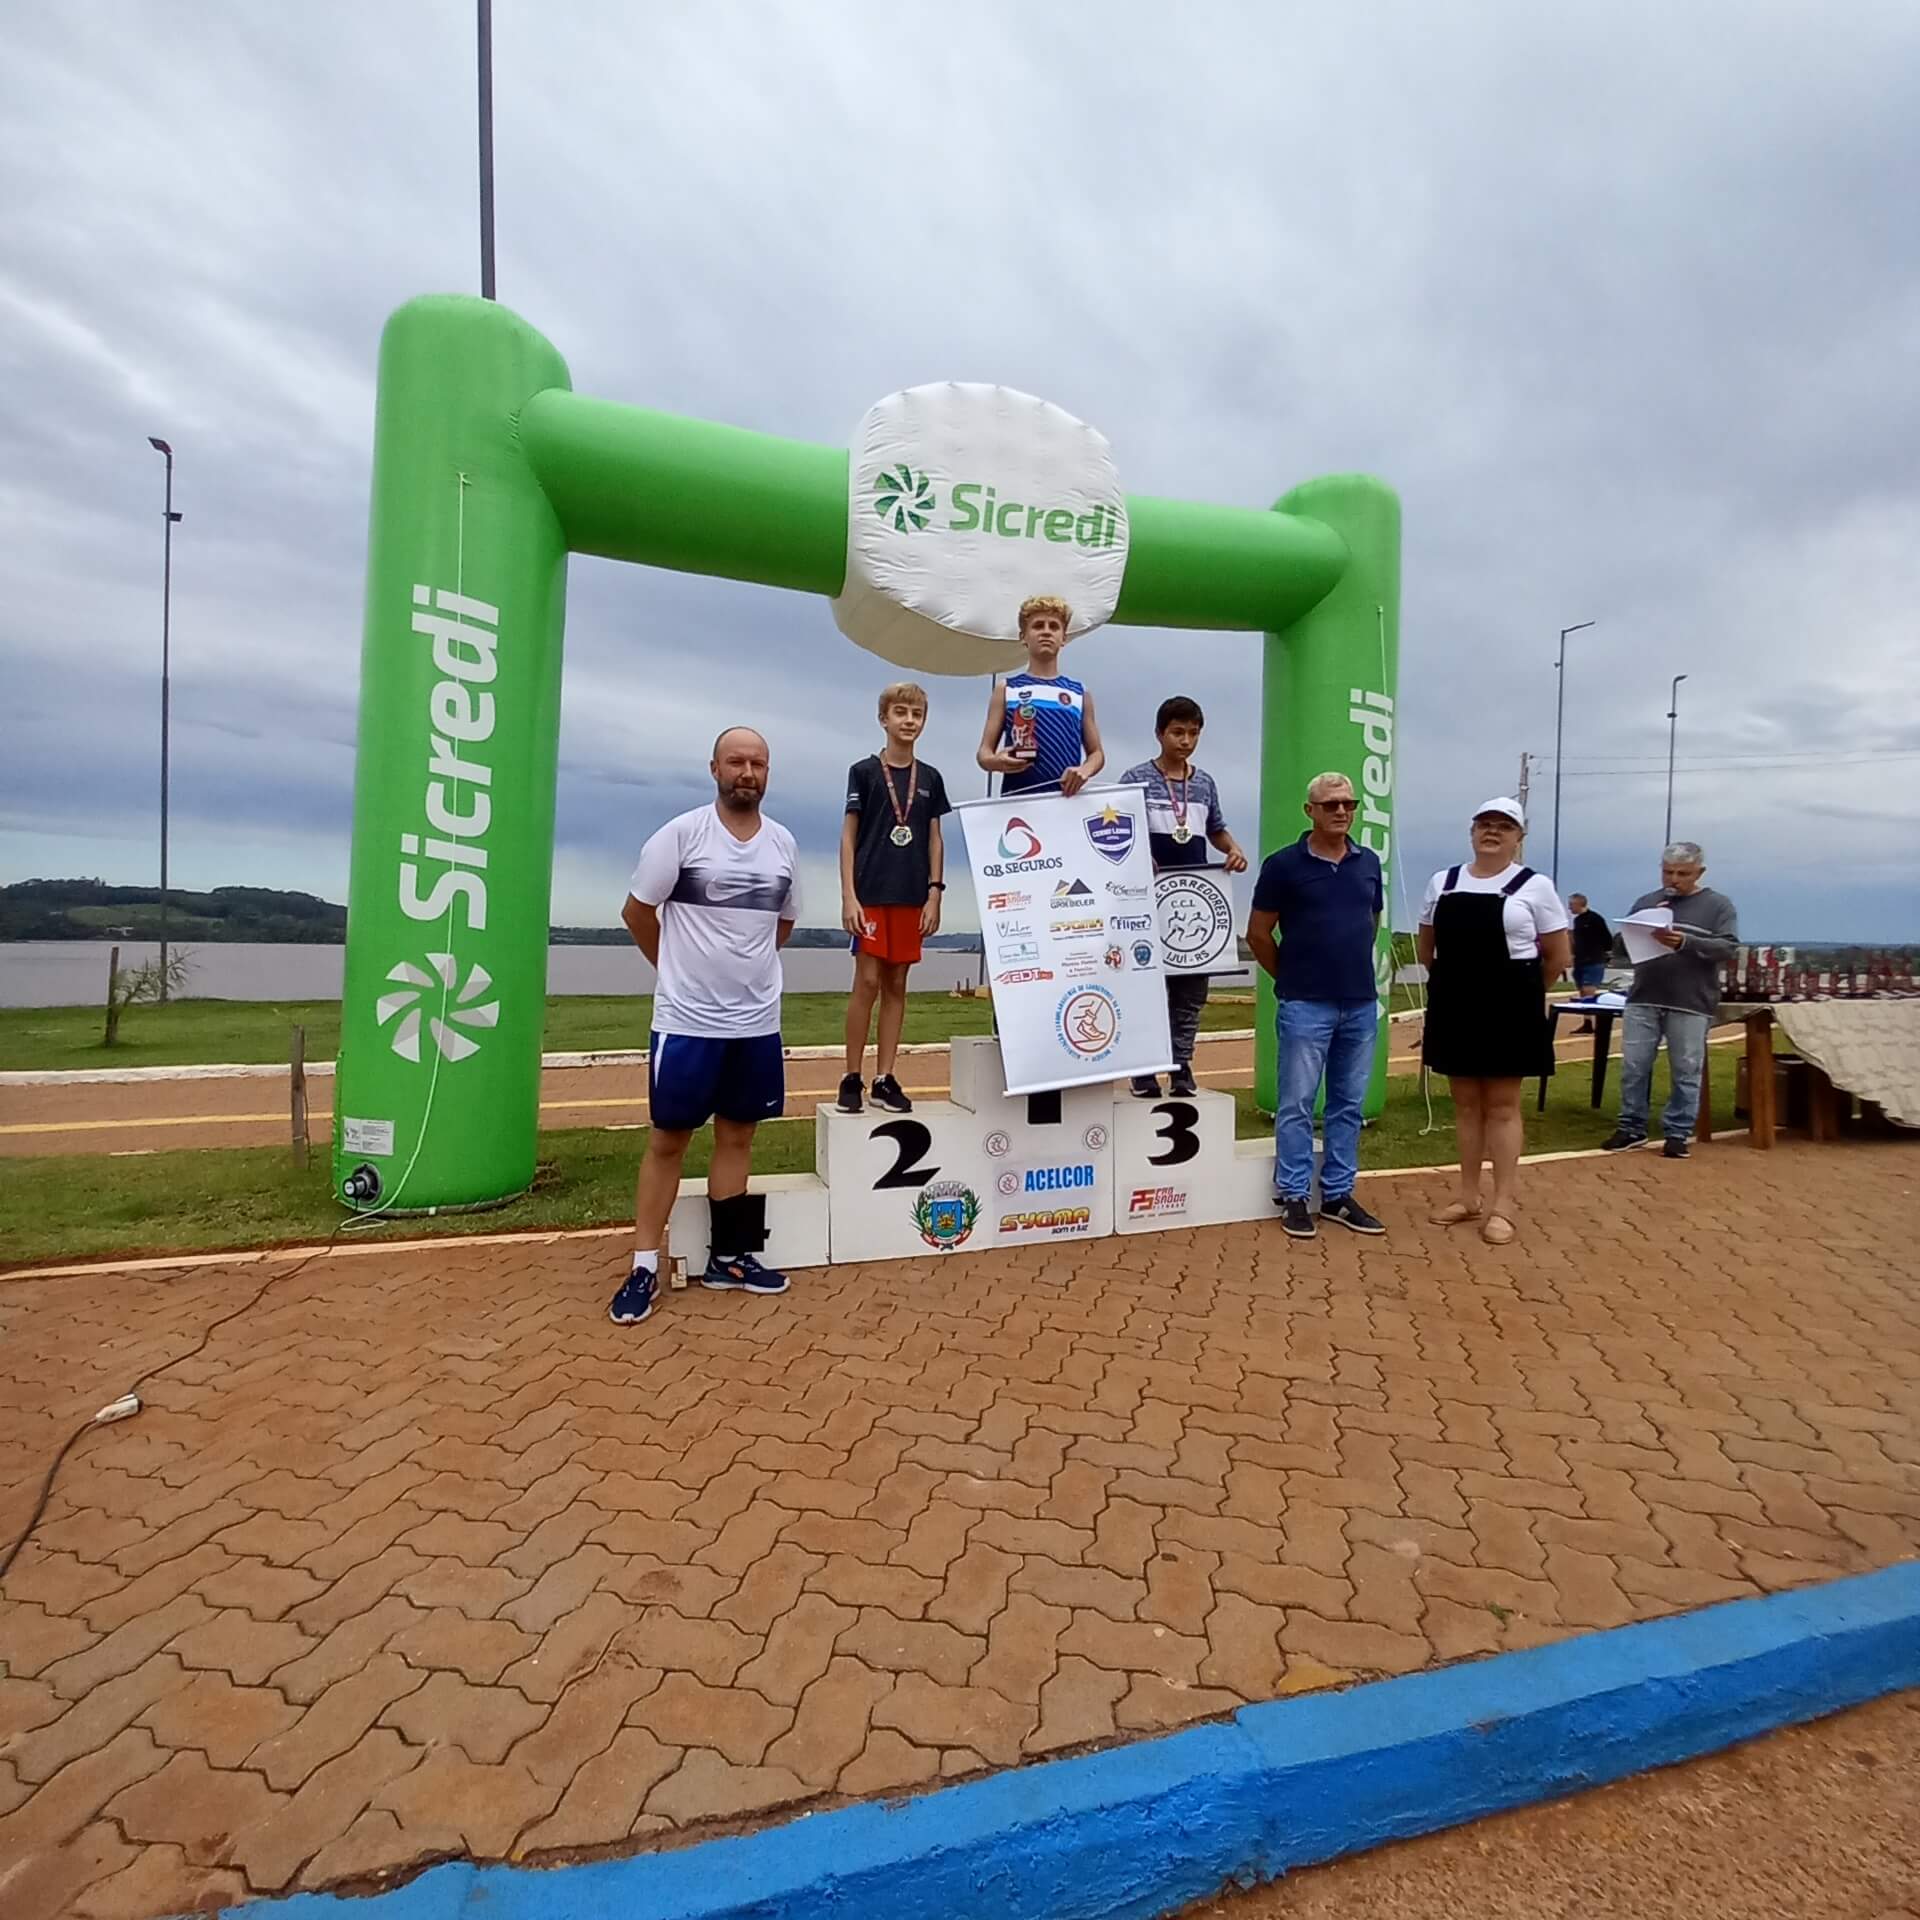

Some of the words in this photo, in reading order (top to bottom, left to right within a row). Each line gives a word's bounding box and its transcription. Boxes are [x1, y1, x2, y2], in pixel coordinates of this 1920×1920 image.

[949, 483, 1117, 548] Sicredi
[400, 583, 500, 930] Sicredi
[1005, 857, 1063, 874] SEGUROS
[1160, 879, 1227, 917] CORREDORES
[1217, 918, 1228, 930] DE
[1195, 949, 1210, 962] RS
[869, 1120, 941, 1190] 2
[1147, 1102, 1200, 1166] 3
[1024, 1165, 1095, 1192] ACELCOR
[1052, 1227, 1069, 1235] som
